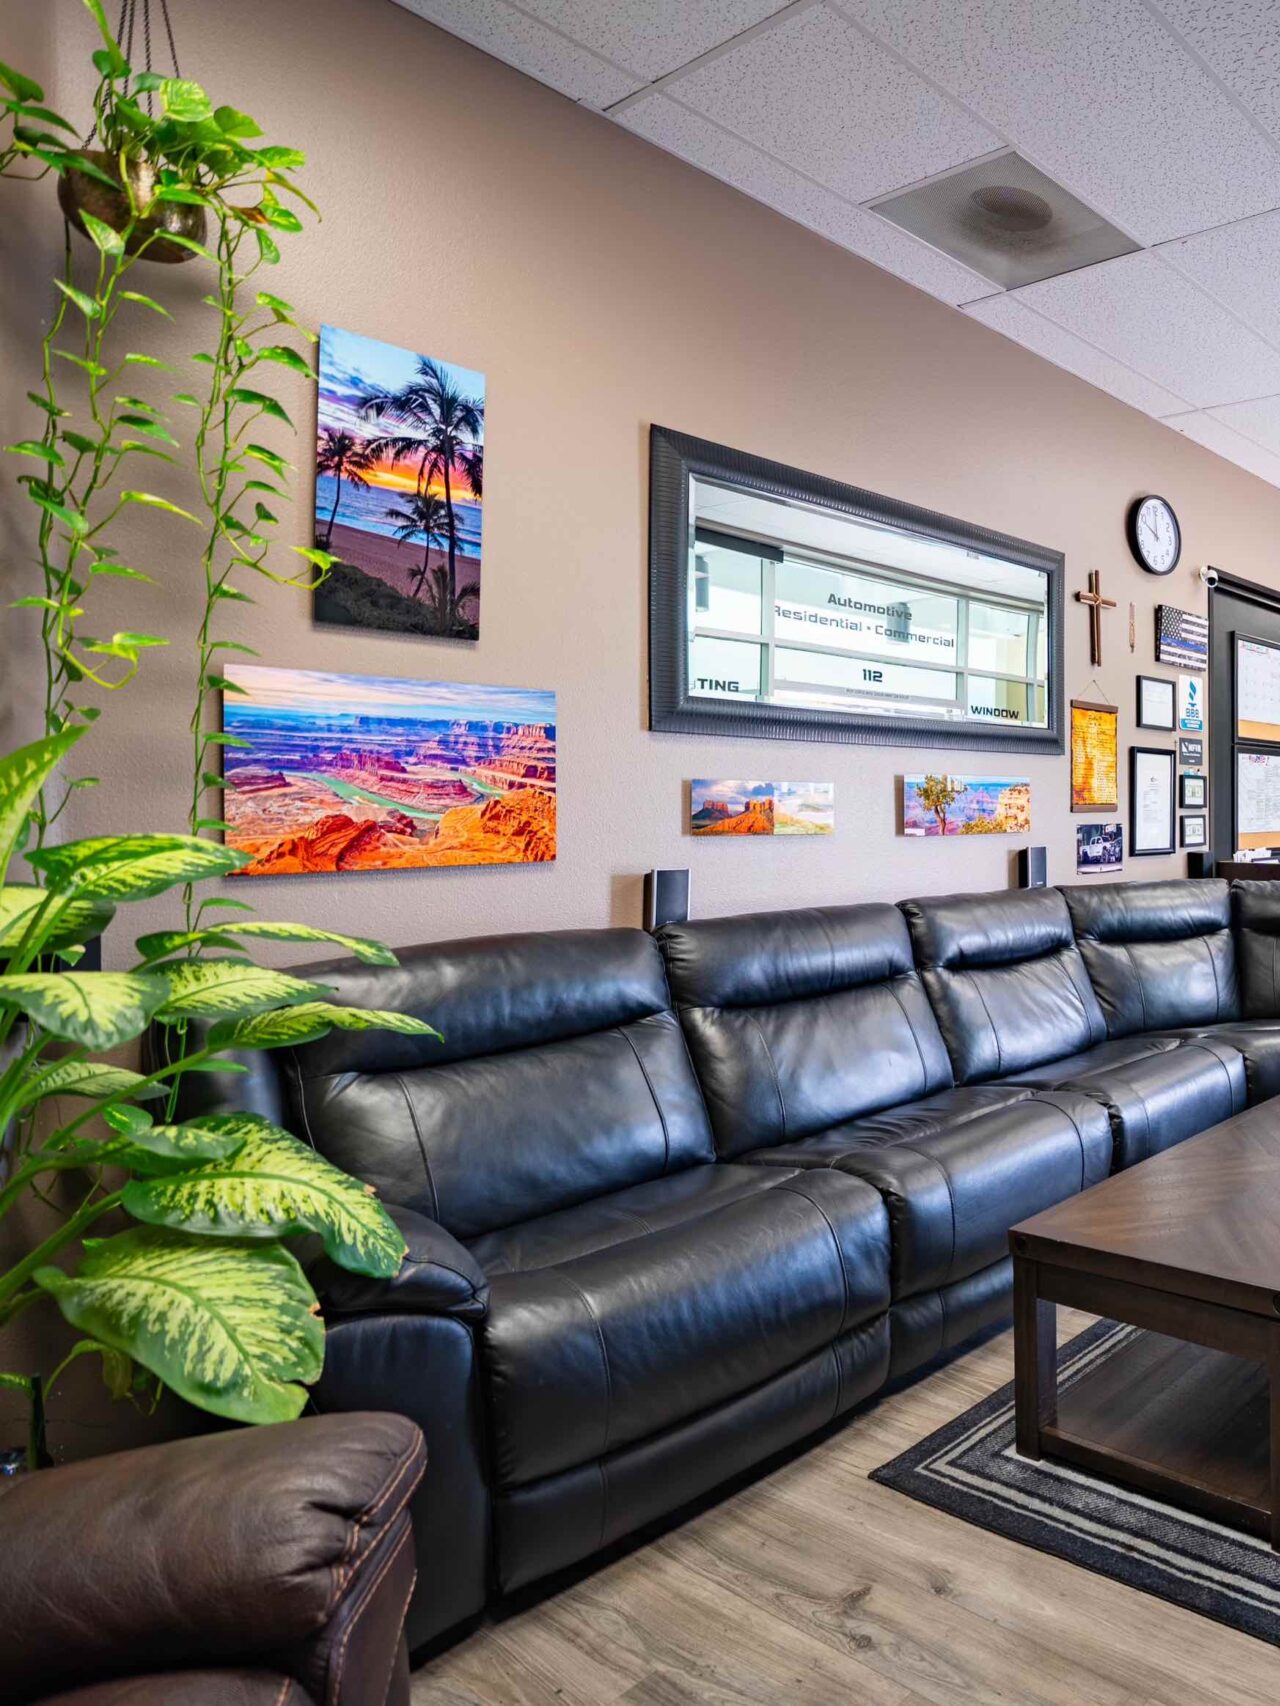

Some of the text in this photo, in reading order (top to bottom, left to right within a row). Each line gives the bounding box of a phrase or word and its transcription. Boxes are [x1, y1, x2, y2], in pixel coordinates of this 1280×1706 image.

[827, 593, 913, 621] Automotive
[875, 624, 955, 648] Commercial
[862, 668, 883, 683] 112
[970, 704, 1020, 720] WINDOW
